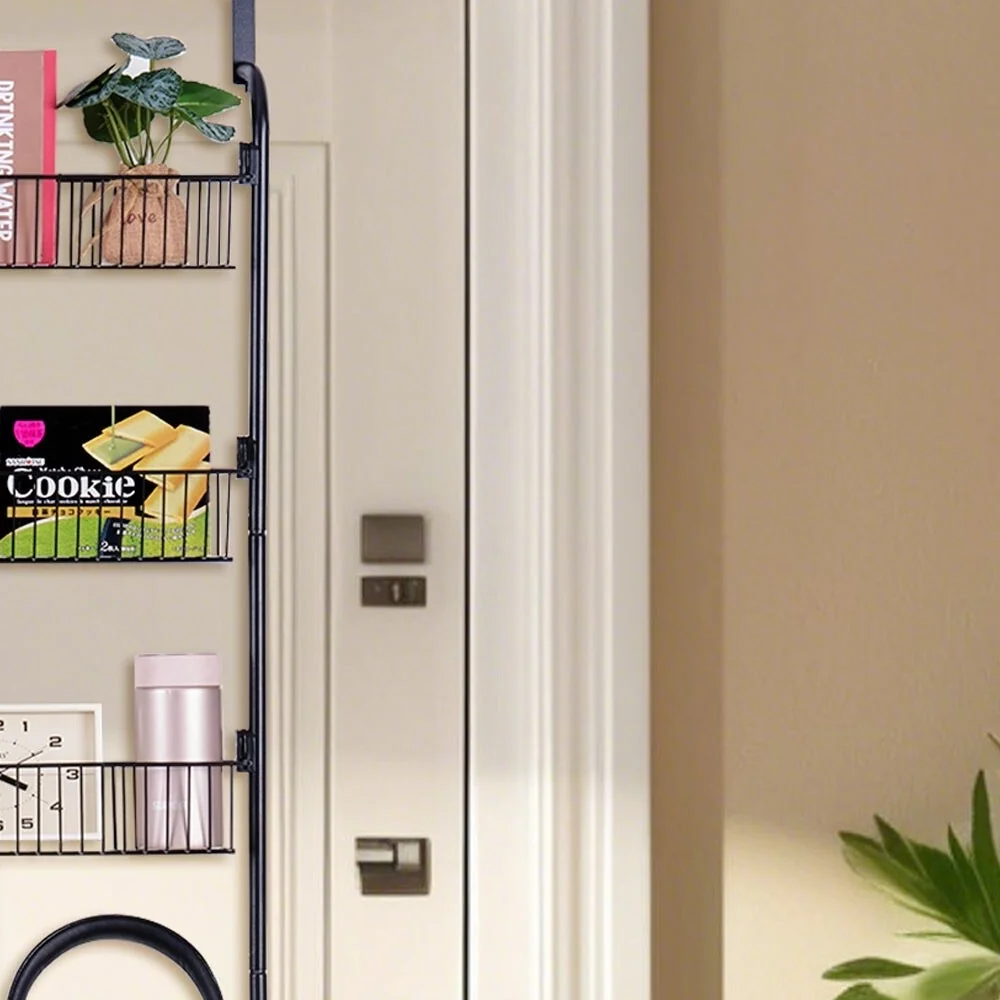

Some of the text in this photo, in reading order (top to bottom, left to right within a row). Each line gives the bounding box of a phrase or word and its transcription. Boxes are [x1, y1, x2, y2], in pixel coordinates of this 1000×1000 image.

[6, 467, 136, 499] Cookie
[22, 721, 28, 732] 1
[49, 736, 62, 748] 2
[66, 769, 79, 780] 3
[49, 802, 63, 813] 4
[21, 818, 34, 829] 5
